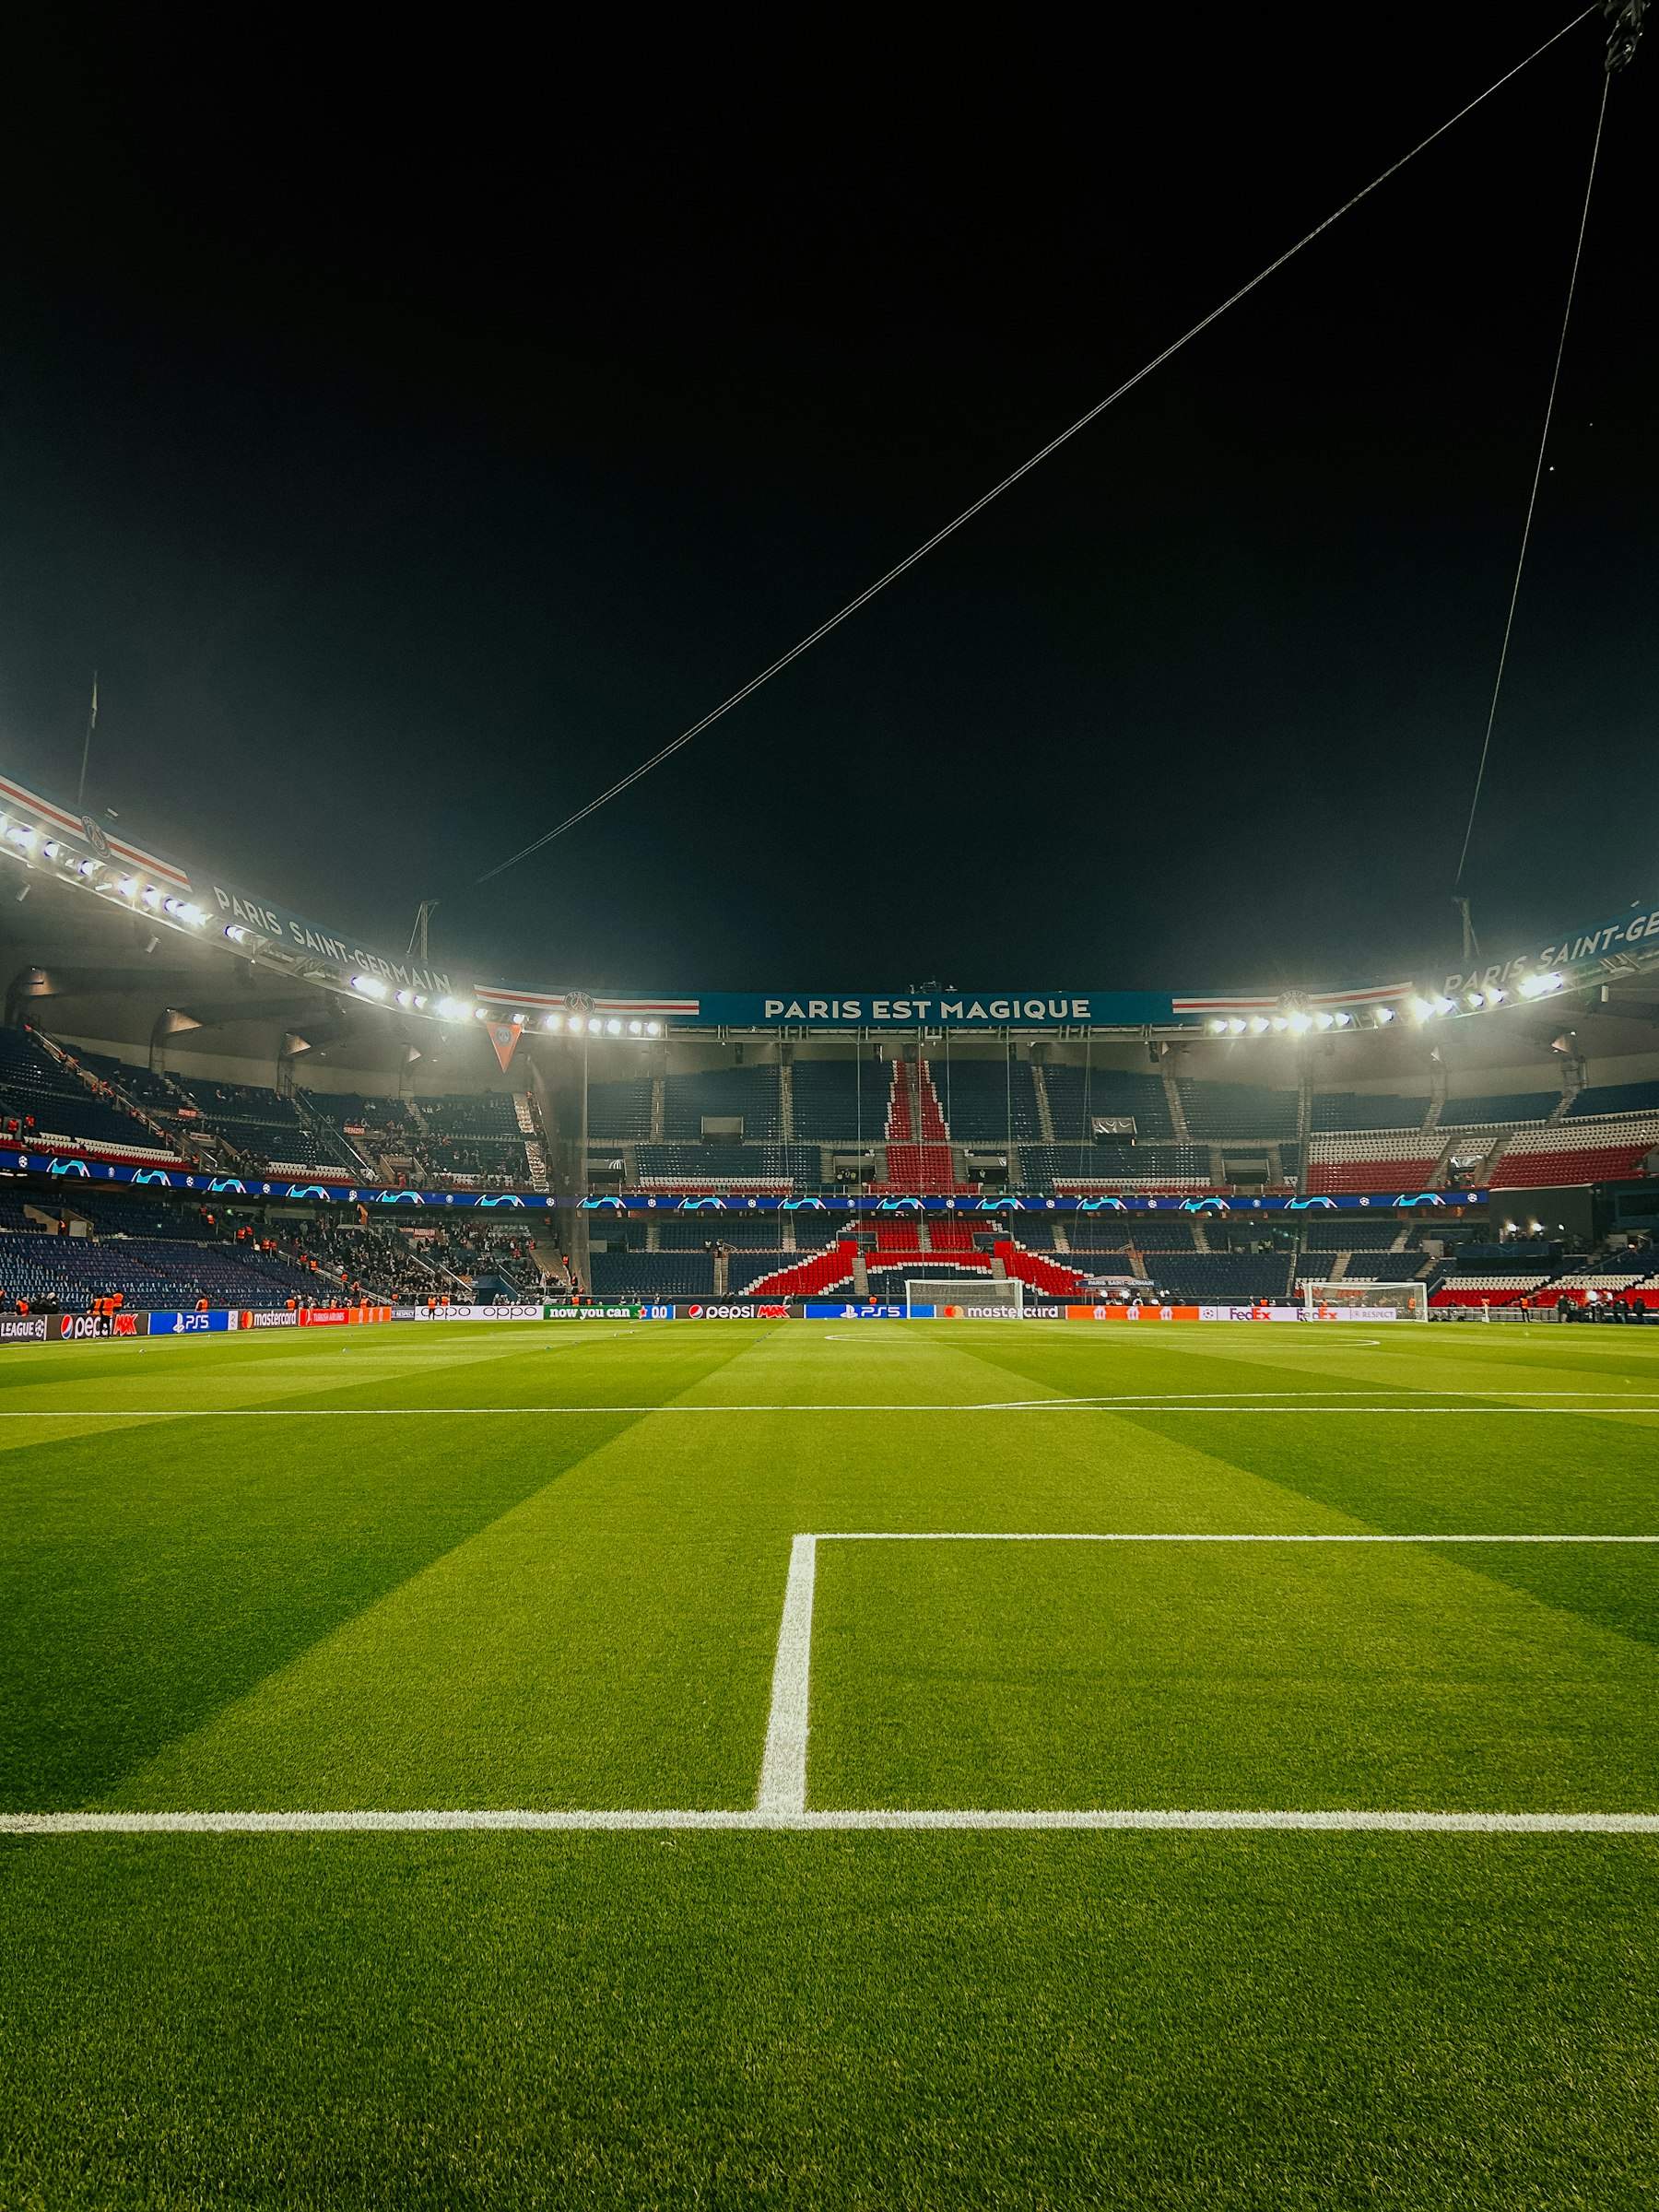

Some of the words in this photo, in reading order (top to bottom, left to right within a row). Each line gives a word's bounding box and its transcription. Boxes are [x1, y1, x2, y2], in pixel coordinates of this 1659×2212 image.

[213, 886, 283, 935] PARIS
[288, 922, 452, 994] SAINT-GERMAIN
[1443, 956, 1527, 995] PARIS
[765, 1000, 862, 1018] PARIS
[873, 1000, 931, 1018] EST
[940, 1000, 1091, 1019] MAGIQUE
[253, 1310, 296, 1326] mastercard
[483, 1307, 537, 1319] oppo
[549, 1308, 579, 1318] now
[580, 1308, 605, 1320] you
[606, 1308, 630, 1318] can
[706, 1304, 755, 1319] pepsi
[757, 1304, 791, 1319] MAX
[861, 1306, 900, 1317] PS5
[968, 1305, 1059, 1318] mastercard
[1230, 1307, 1272, 1321] FedEx
[1297, 1308, 1337, 1320] FedEx
[1, 1322, 34, 1336] LEAGUE
[113, 1314, 138, 1336] MAX
[185, 1314, 209, 1330] PS5
